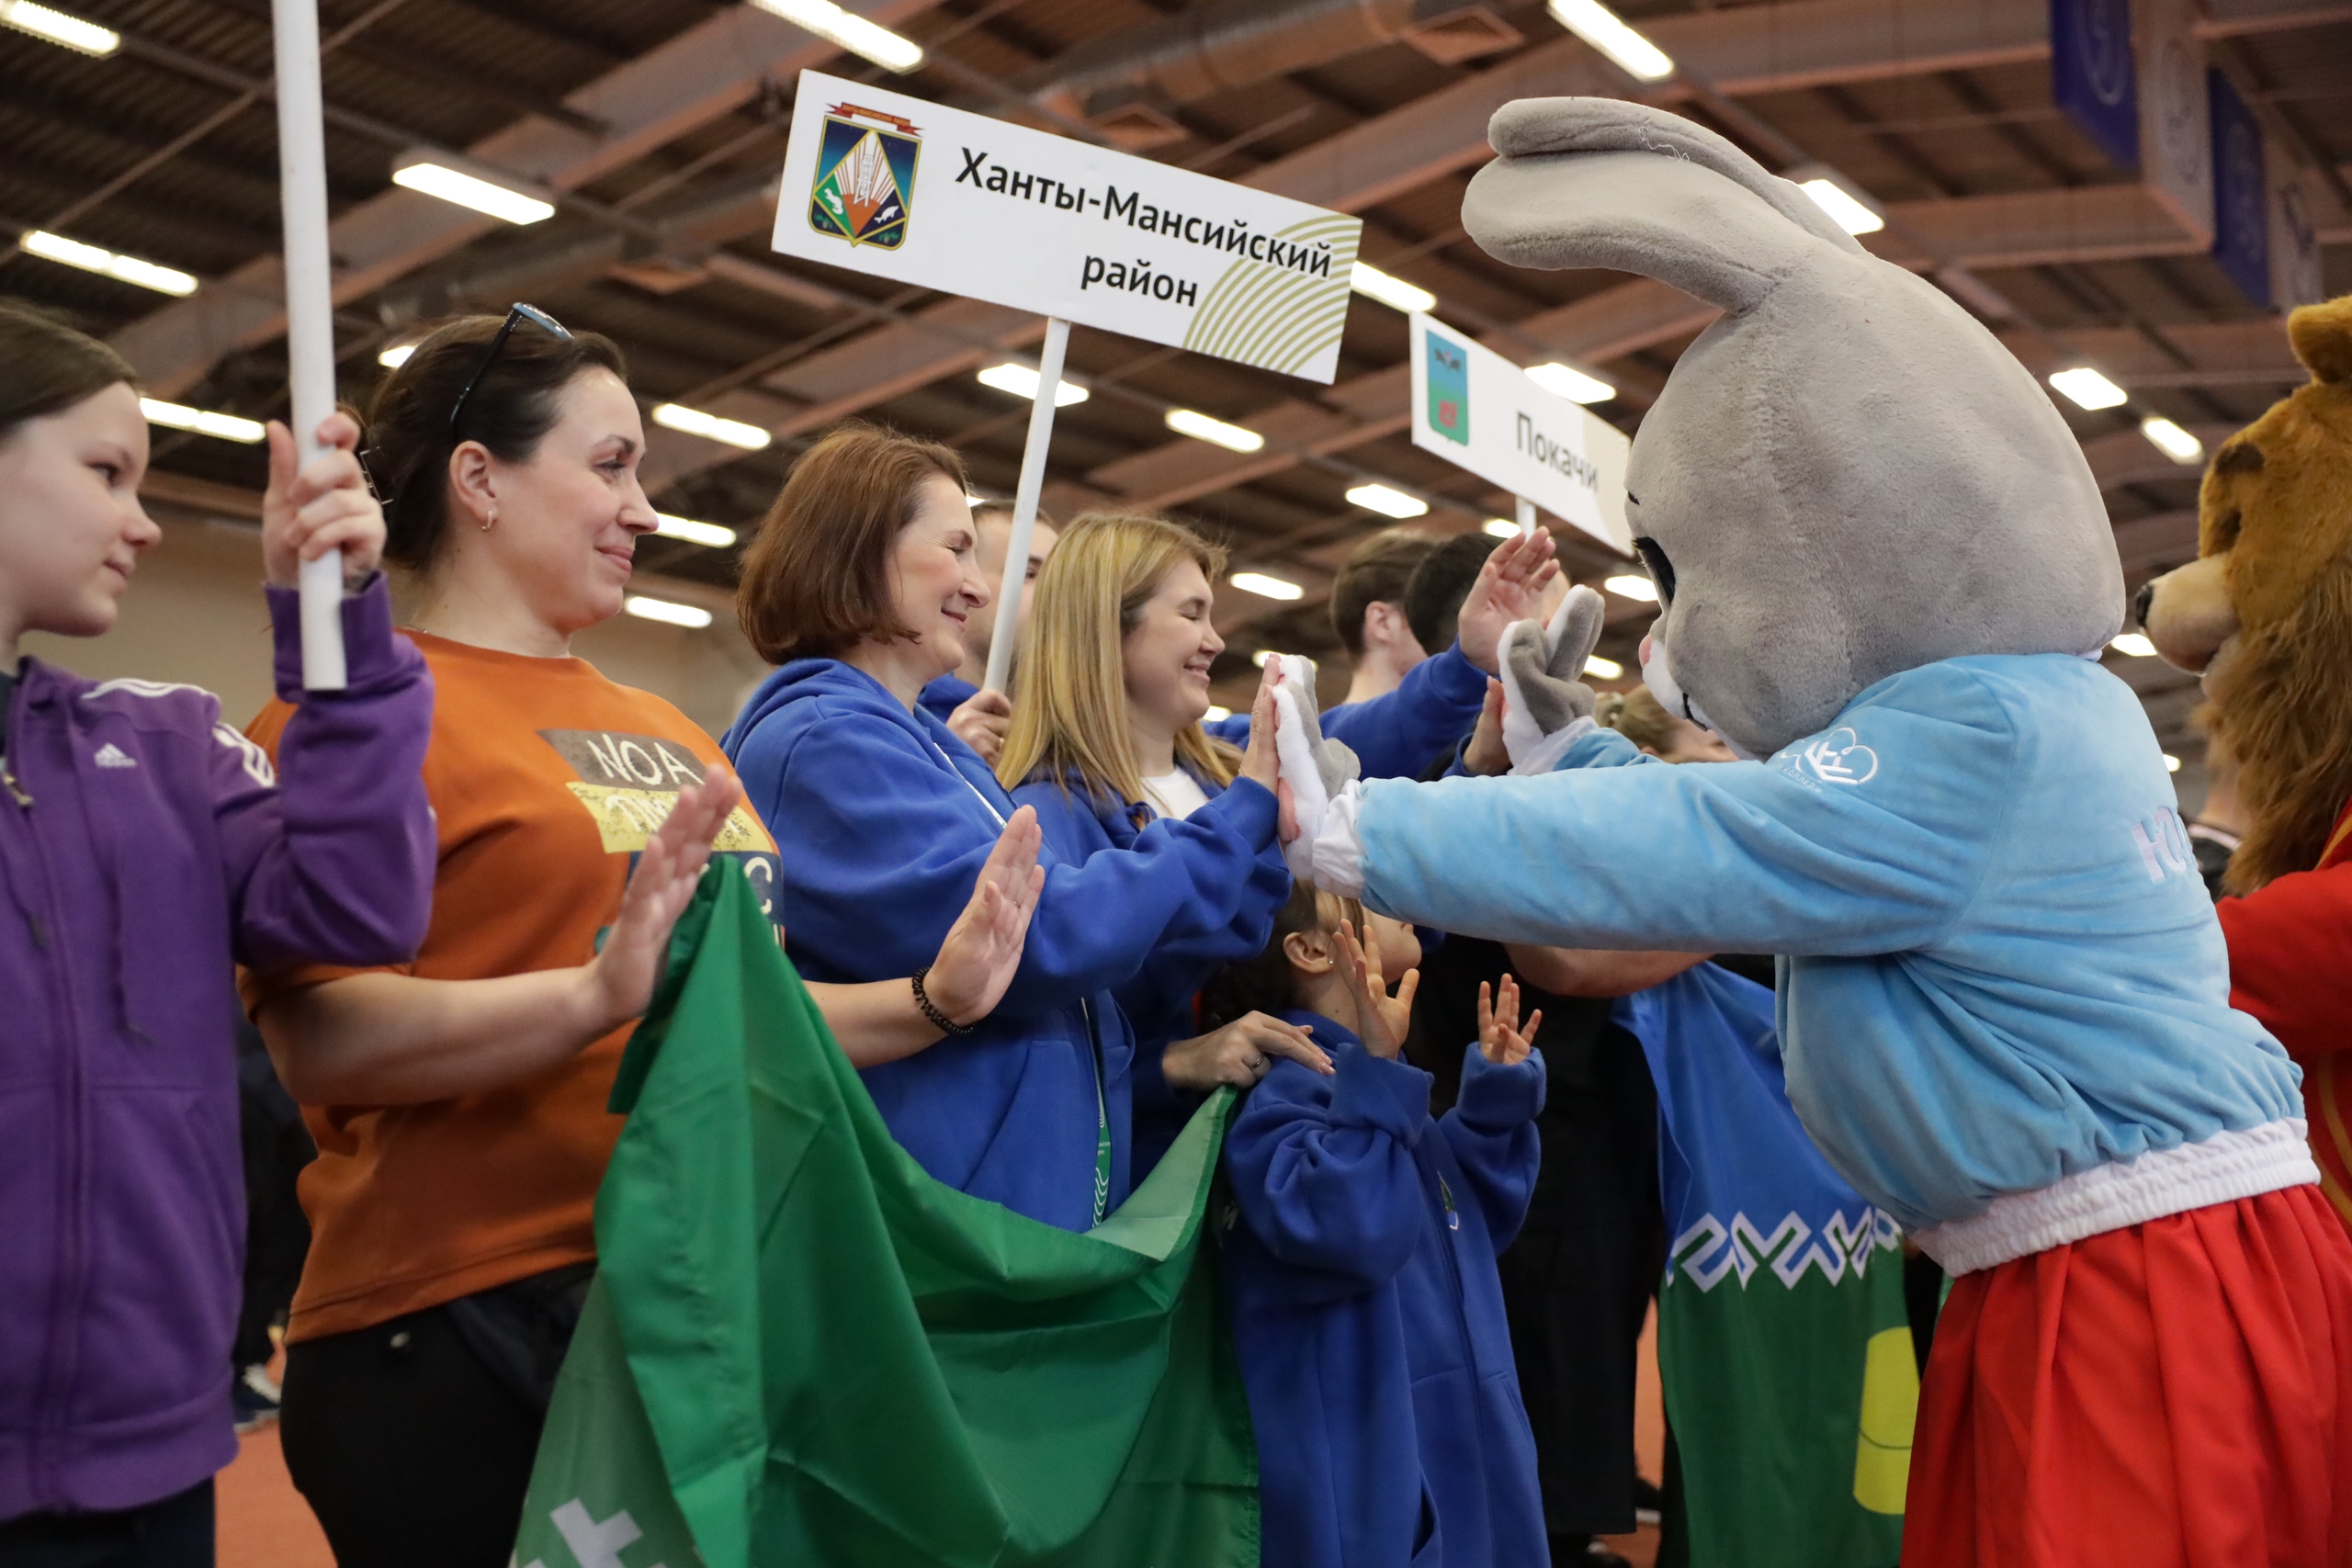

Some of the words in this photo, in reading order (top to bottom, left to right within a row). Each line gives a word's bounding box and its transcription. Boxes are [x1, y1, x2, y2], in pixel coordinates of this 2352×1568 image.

[956, 147, 1333, 278] Ханты-Мансийский
[1080, 254, 1198, 307] район
[1518, 412, 1599, 493] Покачи
